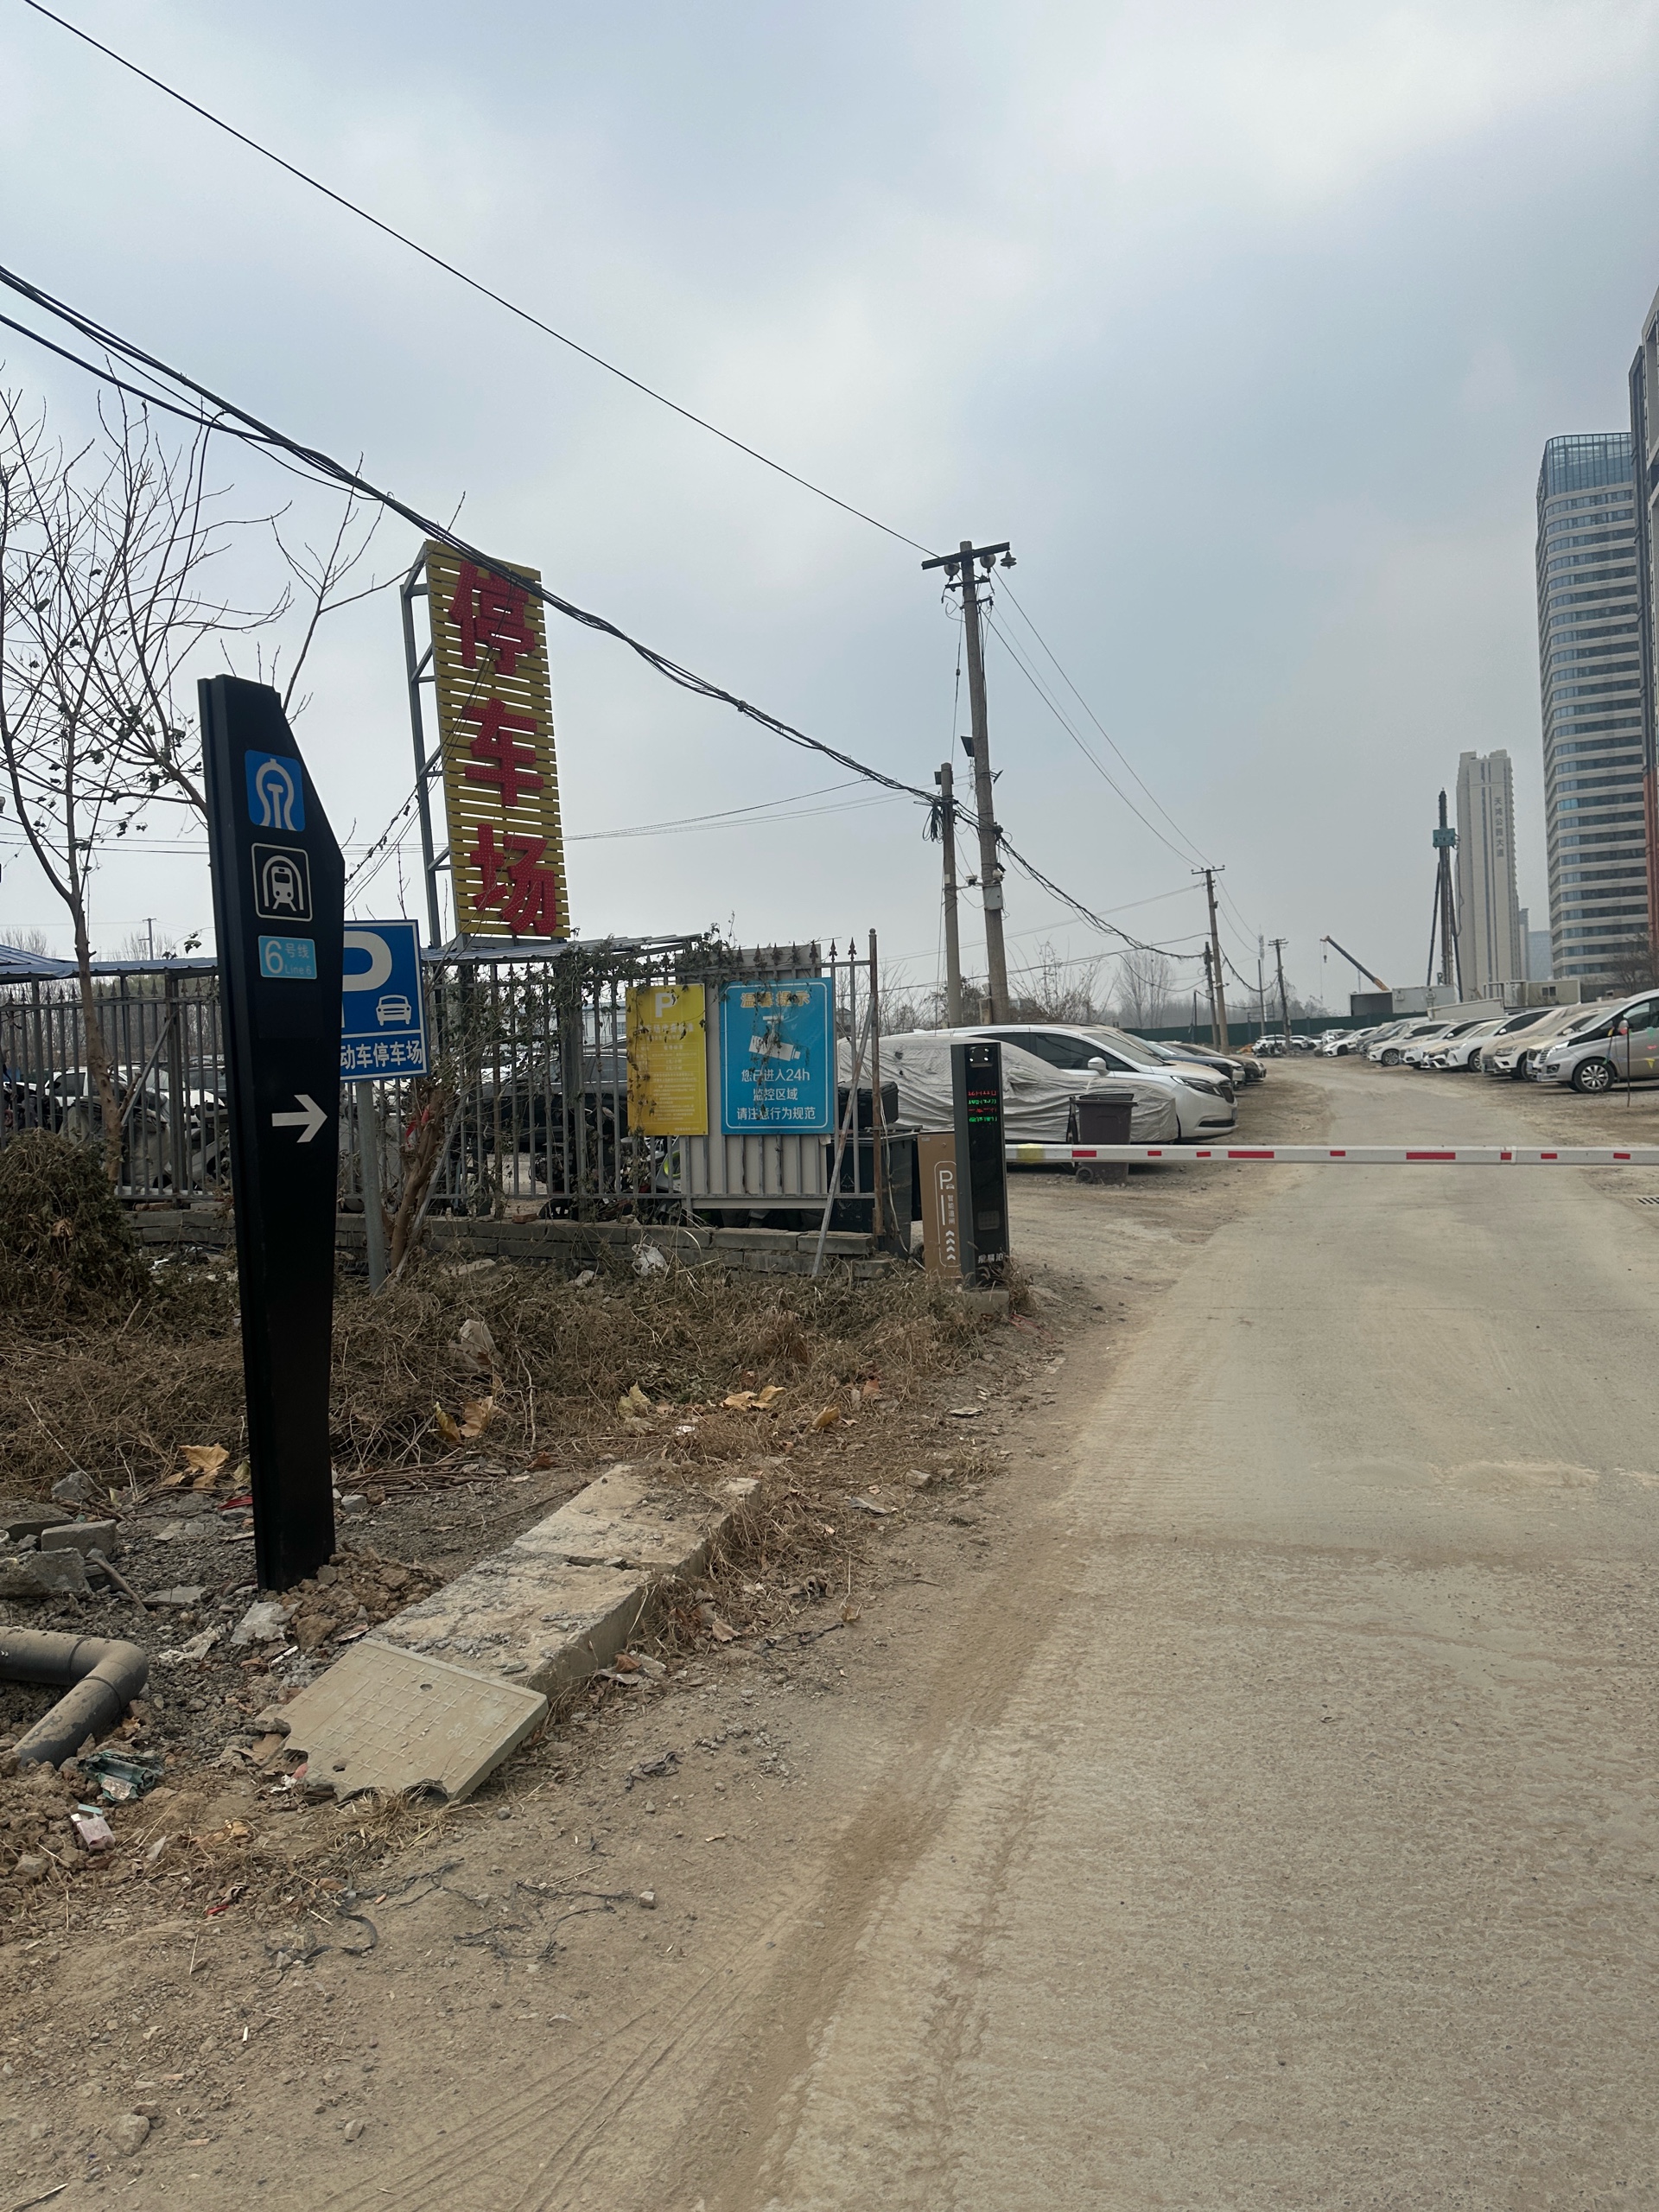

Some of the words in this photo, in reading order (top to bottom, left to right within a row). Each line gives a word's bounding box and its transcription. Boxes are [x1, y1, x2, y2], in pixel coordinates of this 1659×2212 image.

[448, 559, 557, 936] 停车场
[264, 940, 284, 975] 6
[284, 943, 309, 959] 号线
[284, 964, 304, 976] Line
[306, 965, 312, 976] 6
[655, 993, 677, 1018] P
[741, 1068, 810, 1083] 您已进入24h
[753, 1088, 798, 1101] 监控区域
[737, 1107, 816, 1121] 请注意行为规范
[939, 1170, 953, 1190] P
